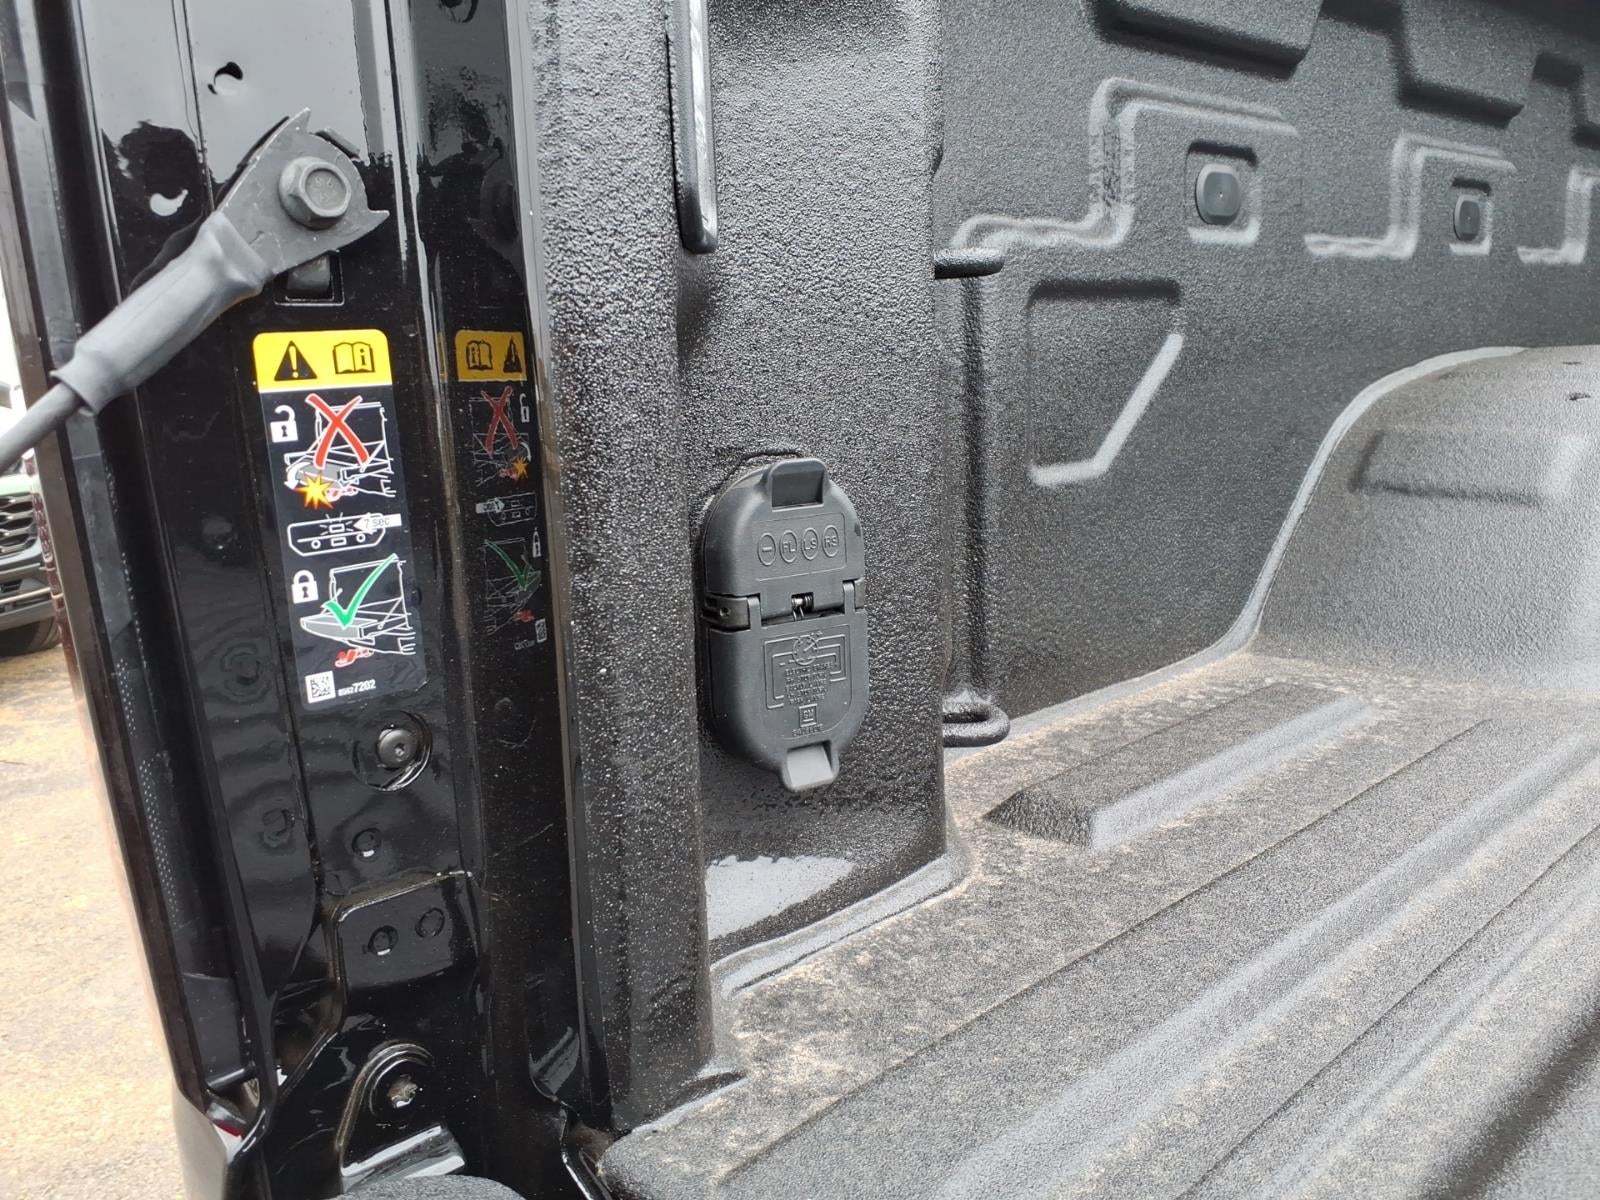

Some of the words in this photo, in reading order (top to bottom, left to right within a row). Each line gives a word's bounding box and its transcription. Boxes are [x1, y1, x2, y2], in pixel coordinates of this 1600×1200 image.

[372, 517, 390, 527] sec
[803, 538, 817, 550] LS
[824, 535, 839, 548] RS
